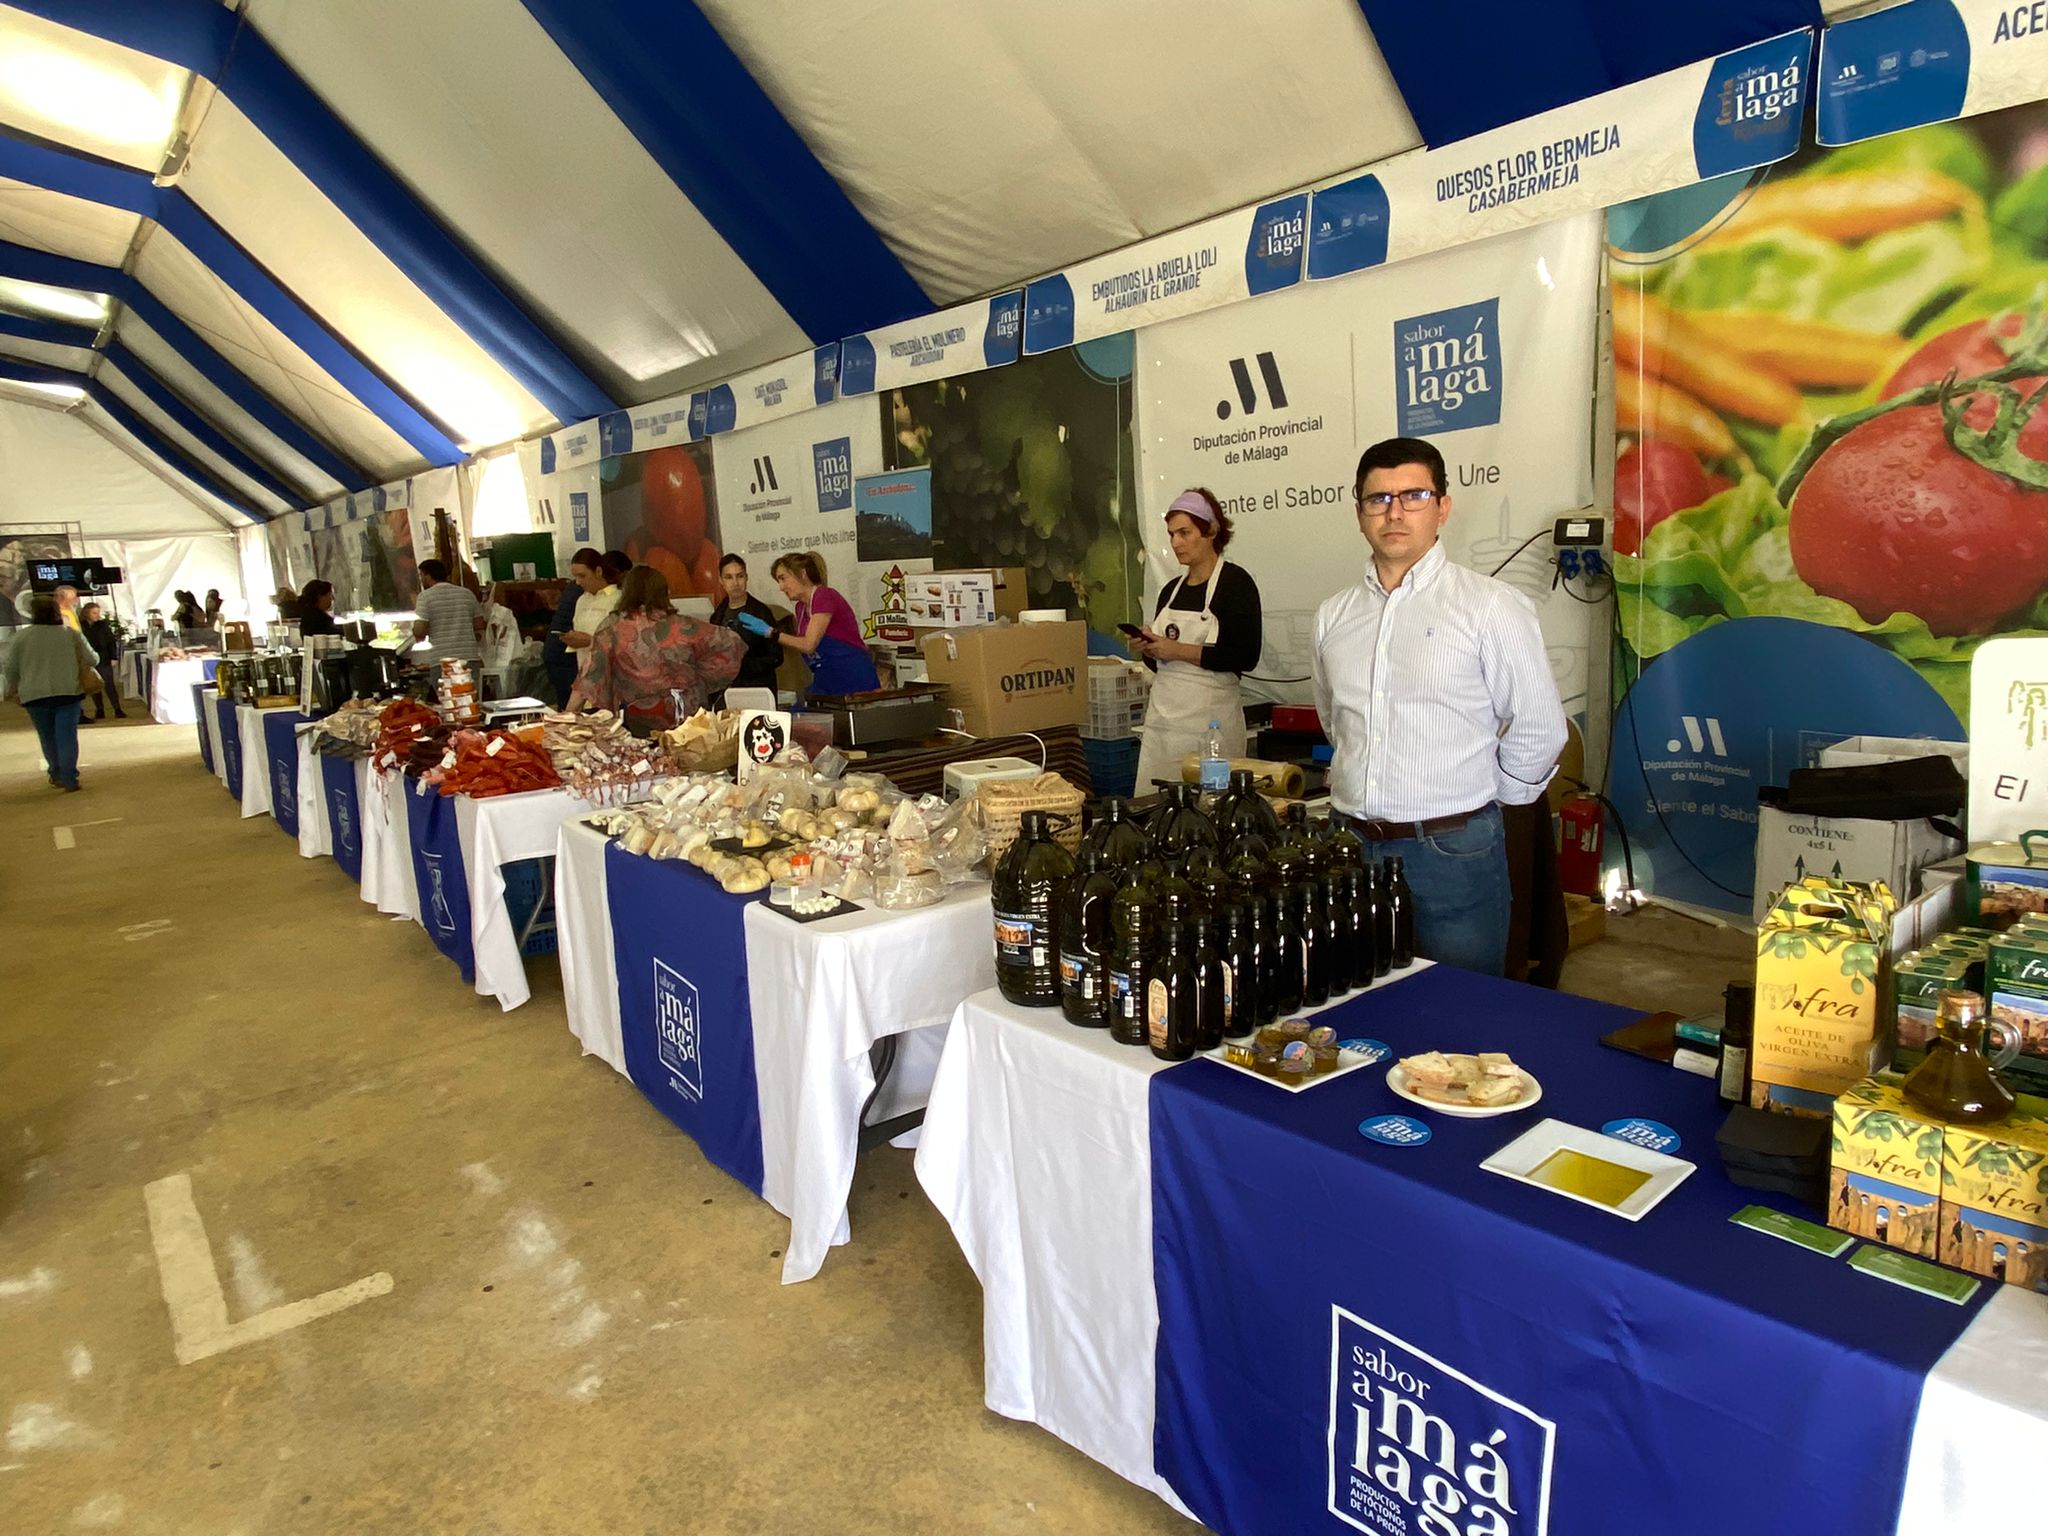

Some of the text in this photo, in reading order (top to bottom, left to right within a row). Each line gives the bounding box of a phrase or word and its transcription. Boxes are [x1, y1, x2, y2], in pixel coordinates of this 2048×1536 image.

[1747, 56, 1800, 98] má
[1735, 87, 1799, 122] laga
[1436, 124, 1620, 202] QUESOS FLOR BERMEJA
[1468, 163, 1579, 214] CASABERMEJA
[1273, 210, 1303, 239] má
[1267, 233, 1302, 256] laga
[1092, 246, 1217, 302] EMBUTIDOS LA ABUELA LOLI
[1150, 285, 1161, 301] EL
[1163, 271, 1202, 297] GRANDE
[996, 321, 1019, 338] laga
[1404, 324, 1445, 343] sabor
[1404, 316, 1489, 373] a má
[1406, 365, 1492, 411] laga
[1193, 415, 1323, 452] Diputación Provincial
[822, 446, 849, 474] má
[1224, 445, 1289, 466] de Málaga
[819, 474, 849, 498] laga
[1218, 493, 1258, 518] ente
[1262, 488, 1279, 511] el
[1285, 483, 1344, 510] Sabor
[1459, 464, 1501, 488] Une
[780, 535, 803, 550] Sabor
[804, 534, 821, 550] que
[1000, 666, 1075, 693] ORTIPAN
[1643, 760, 1750, 777] Diputación Provincial
[1671, 771, 1726, 787] de Málaga
[1994, 774, 2029, 802] El
[1647, 800, 1758, 824] Siente el Sabo
[665, 992, 695, 1036] má
[660, 1004, 697, 1062] laga
[1775, 1025, 1847, 1043] ACEITE DE
[1788, 1038, 1829, 1051] OLIVA
[1759, 1042, 1860, 1066] VIRGEN EXTRA
[1352, 1345, 1431, 1401] sabor
[1352, 1370, 1518, 1515] a má
[1350, 1475, 1401, 1515] PRODUCTOS
[1350, 1487, 1407, 1531] AUTÓCTONOS
[1350, 1498, 1362, 1513] DE
[1364, 1505, 1375, 1522] LA
